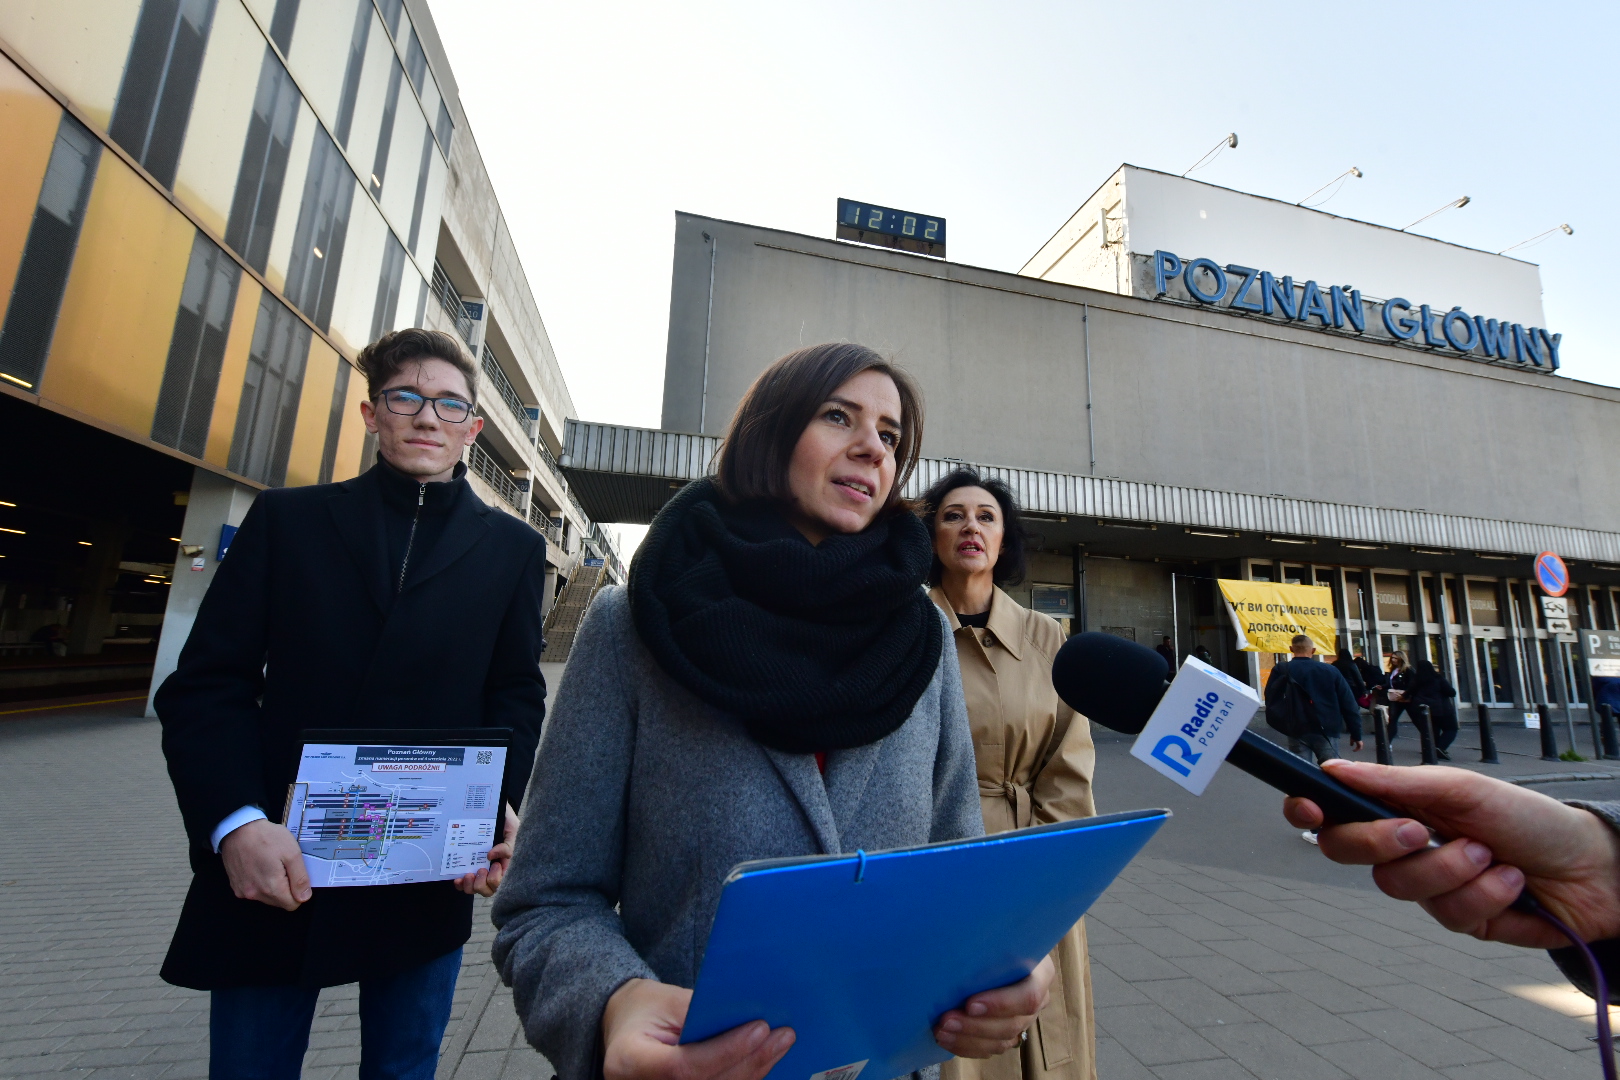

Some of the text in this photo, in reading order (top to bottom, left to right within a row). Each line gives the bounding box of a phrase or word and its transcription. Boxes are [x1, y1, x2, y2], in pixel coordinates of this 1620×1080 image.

[855, 207, 938, 240] 12:02
[1153, 249, 1562, 369] POZNAŃ GŁÓWNY
[1248, 602, 1262, 612] ви
[1266, 603, 1328, 616] отримаєте
[1375, 593, 1408, 606] FOODHALL
[1248, 622, 1307, 636] допомогу
[1588, 634, 1601, 655] P
[1180, 691, 1219, 738] Radio
[1199, 700, 1234, 747] Poznań
